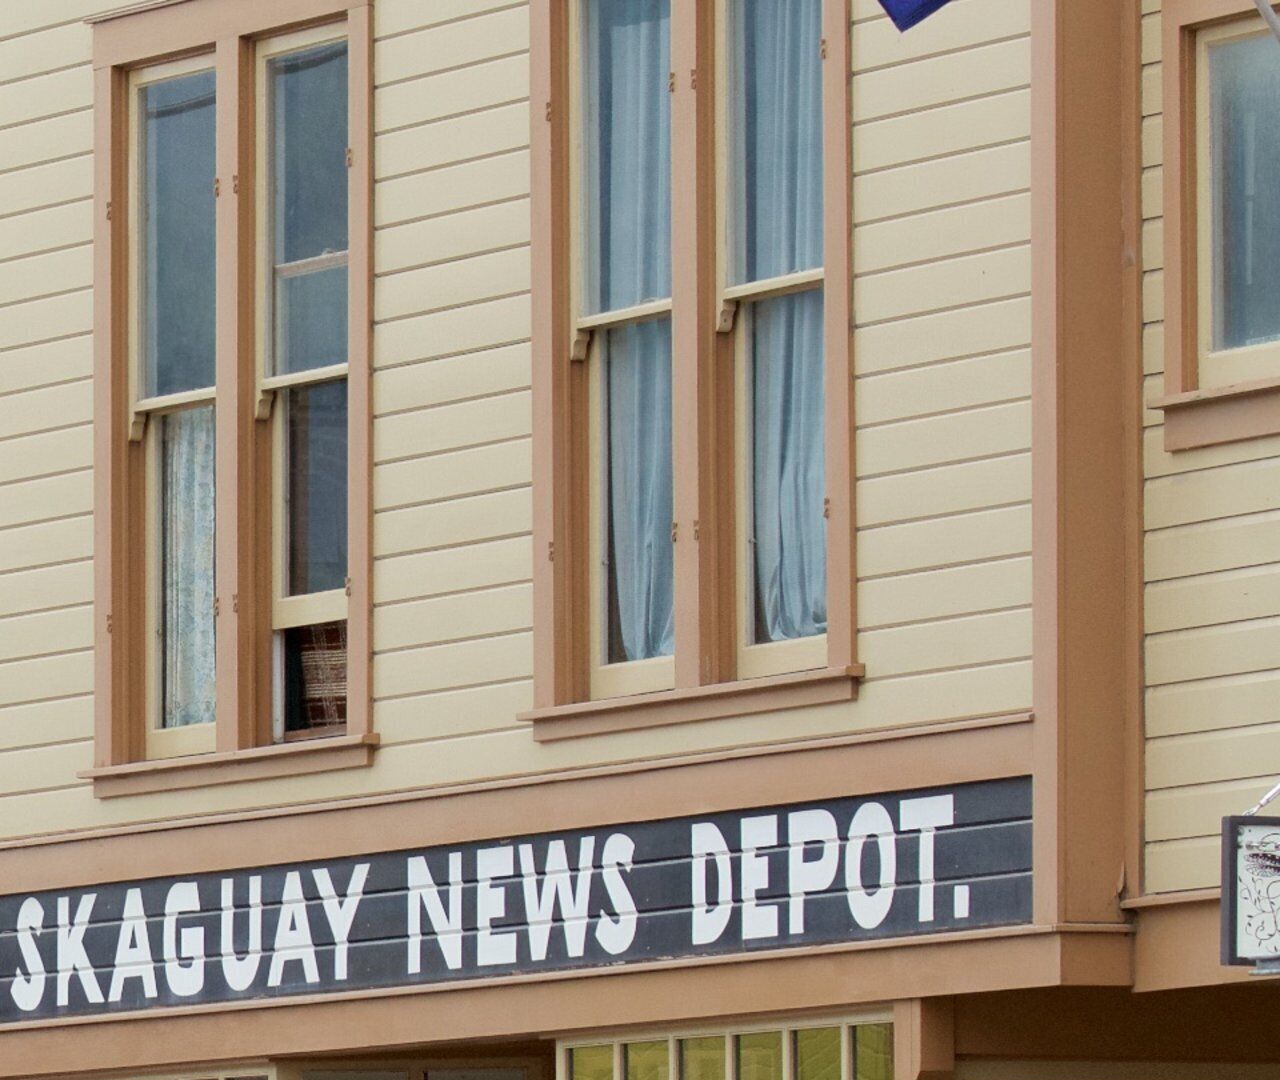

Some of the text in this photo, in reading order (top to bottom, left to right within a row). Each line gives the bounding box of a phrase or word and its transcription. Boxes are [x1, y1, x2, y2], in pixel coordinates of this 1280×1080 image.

[11, 794, 970, 1011] SKAGUAY NEWS DEPOT.
